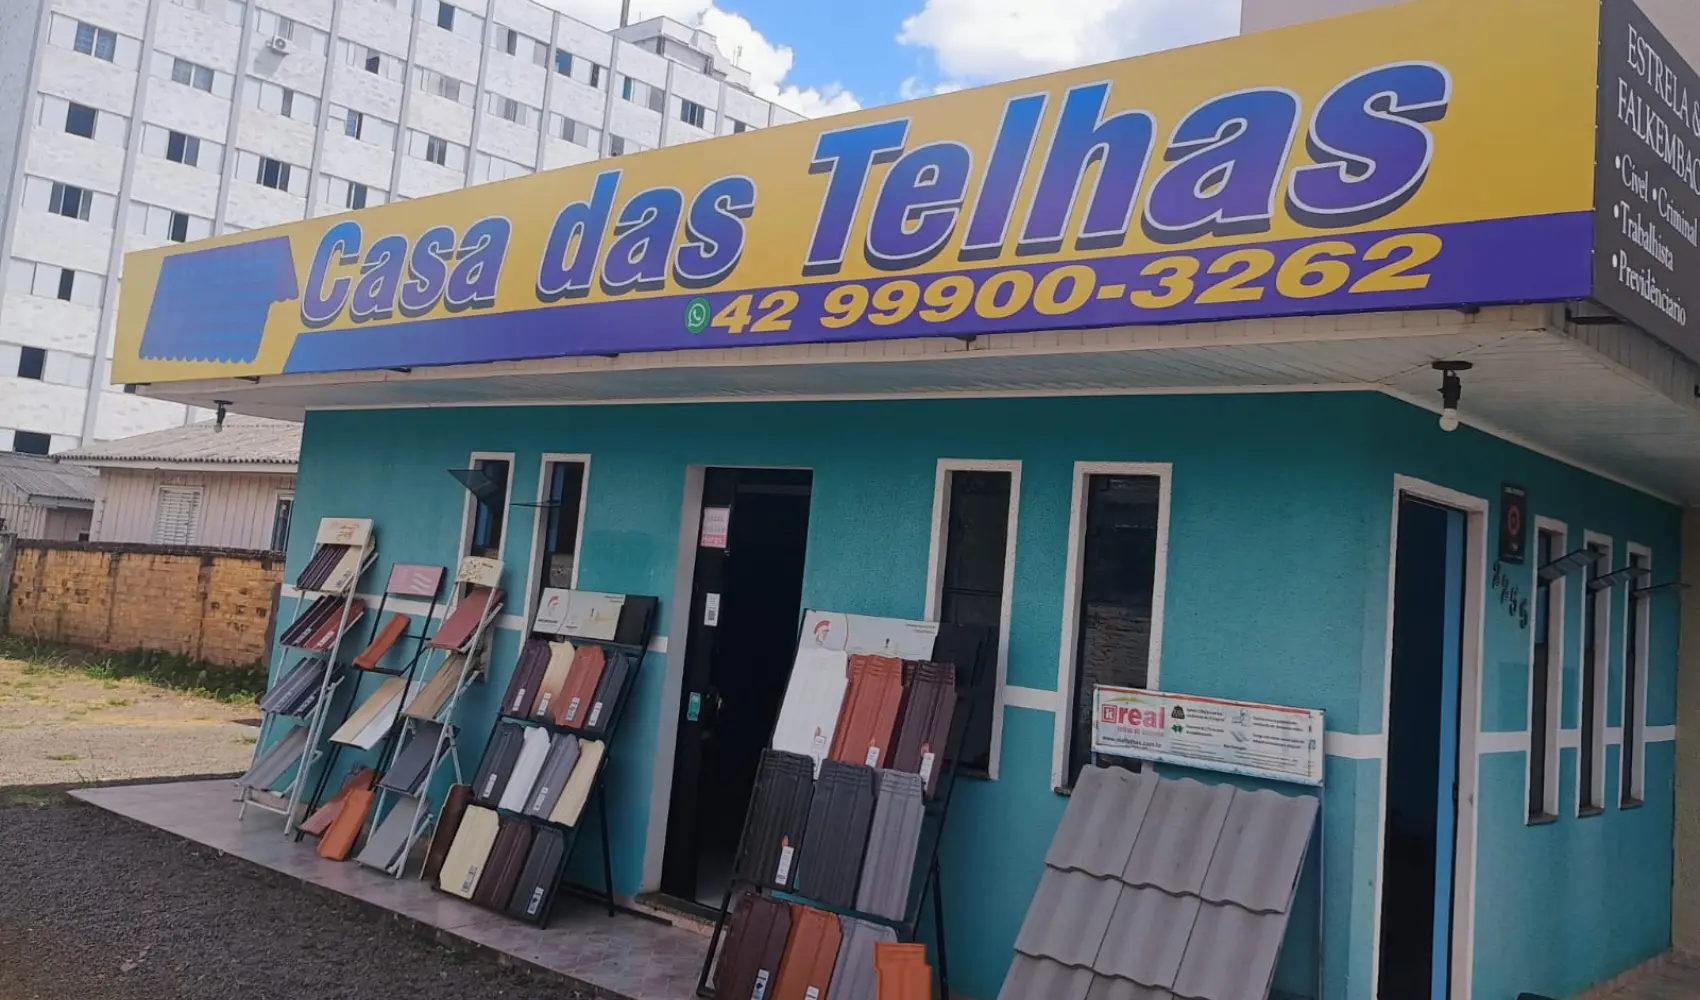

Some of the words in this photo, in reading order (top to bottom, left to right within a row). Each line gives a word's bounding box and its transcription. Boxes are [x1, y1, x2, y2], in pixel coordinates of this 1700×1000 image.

[1627, 23, 1690, 128] ESTRELA
[300, 215, 511, 329] Casa
[536, 169, 756, 303] das
[801, 60, 1452, 277] Telhas
[1620, 200, 1674, 272] Trabalhista
[1621, 154, 1649, 203] Cível
[1658, 186, 1698, 247] Criminal
[710, 289, 799, 333] 42
[819, 233, 1443, 330] 99900-3262
[1118, 706, 1165, 729] real
